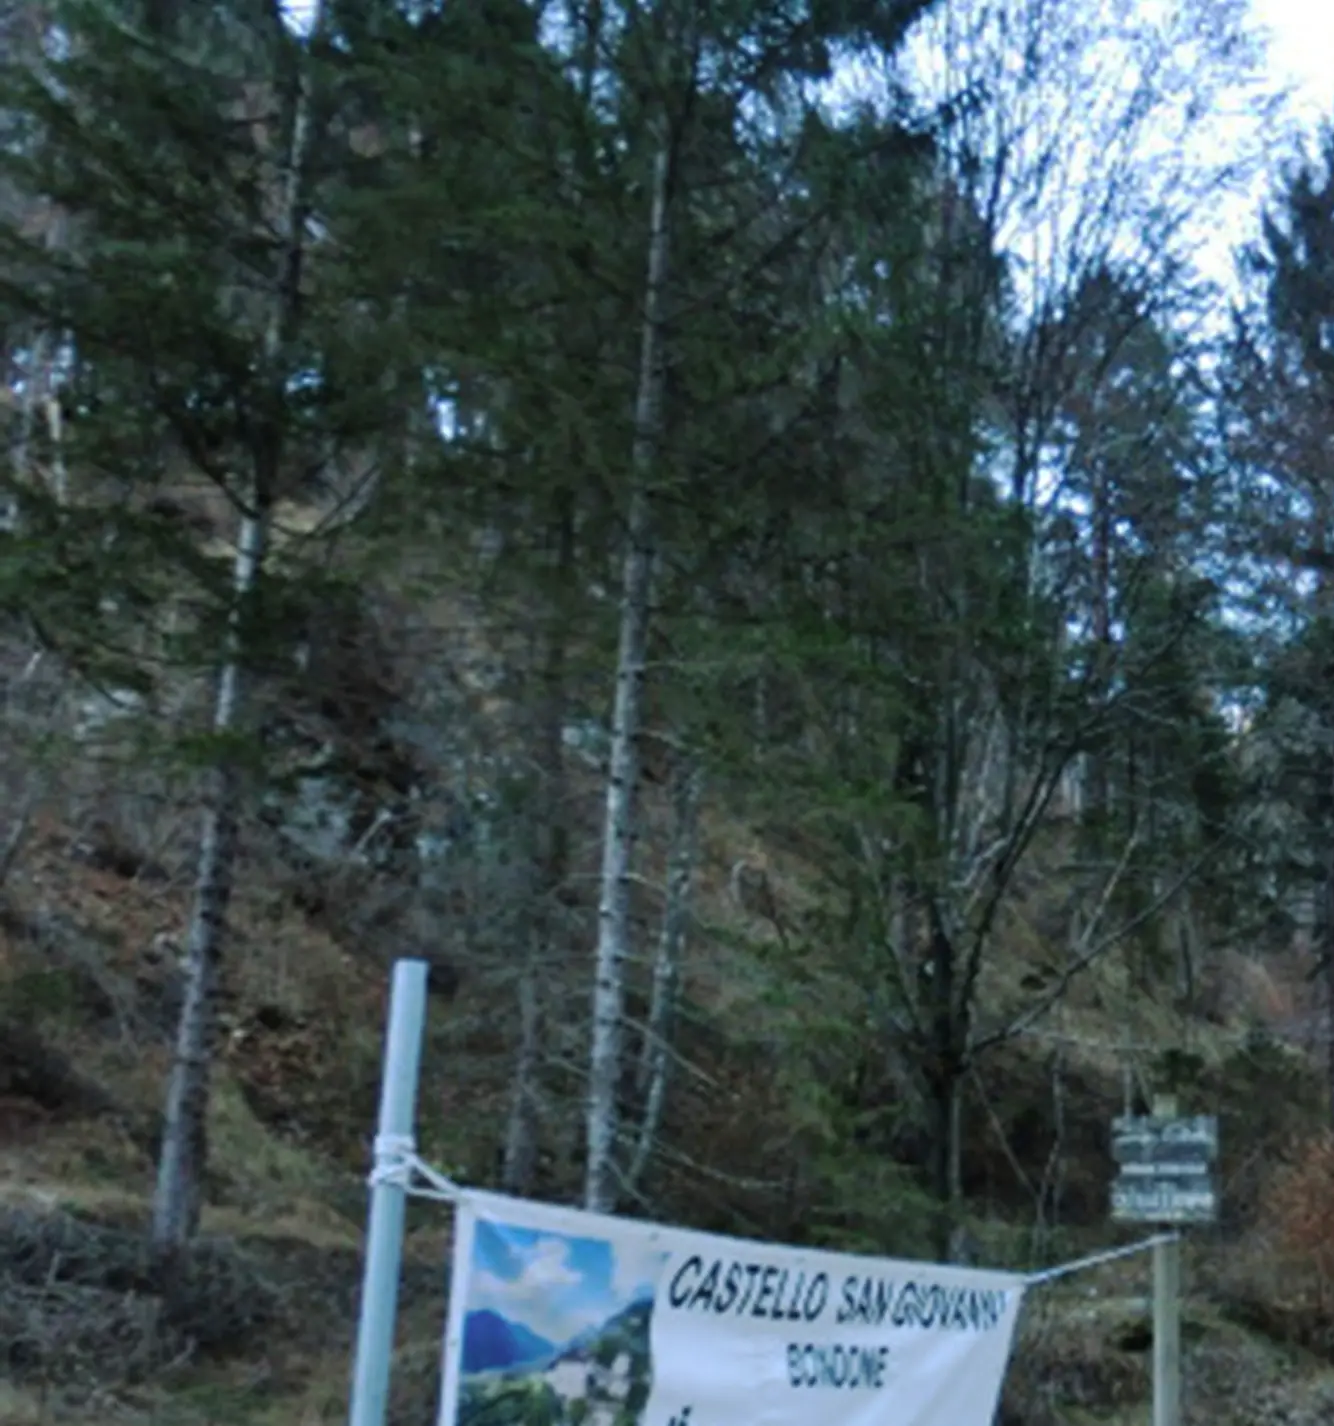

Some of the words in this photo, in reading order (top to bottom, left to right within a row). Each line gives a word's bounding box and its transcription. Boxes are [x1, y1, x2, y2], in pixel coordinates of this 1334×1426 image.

[668, 1254, 829, 1322] CASTELLO
[835, 1275, 895, 1325] SAN
[786, 1342, 889, 1389] BONDONE
